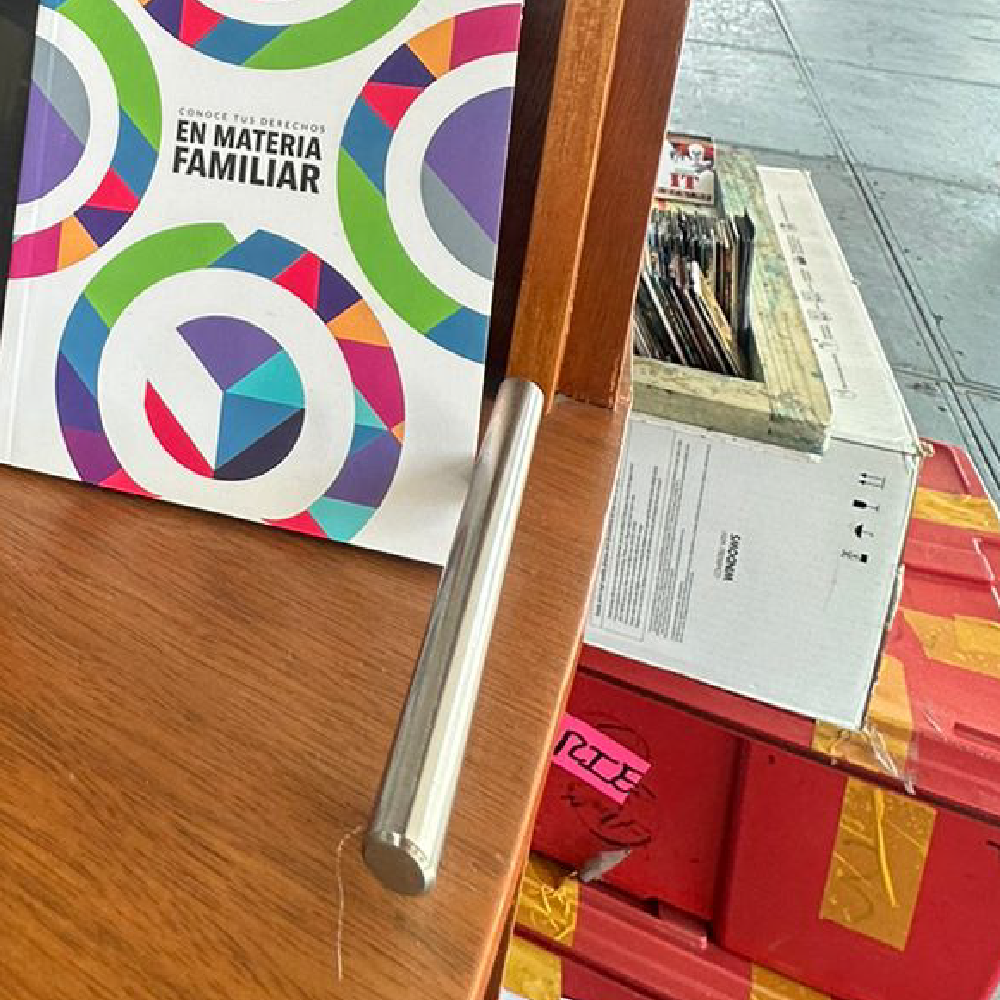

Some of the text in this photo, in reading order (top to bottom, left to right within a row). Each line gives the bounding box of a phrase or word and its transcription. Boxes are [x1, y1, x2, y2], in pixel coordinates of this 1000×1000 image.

[176, 118, 323, 161] EN MATERIA
[178, 107, 326, 134] CONOCE TUS DERECHOS
[172, 145, 321, 195] FAMILIAR
